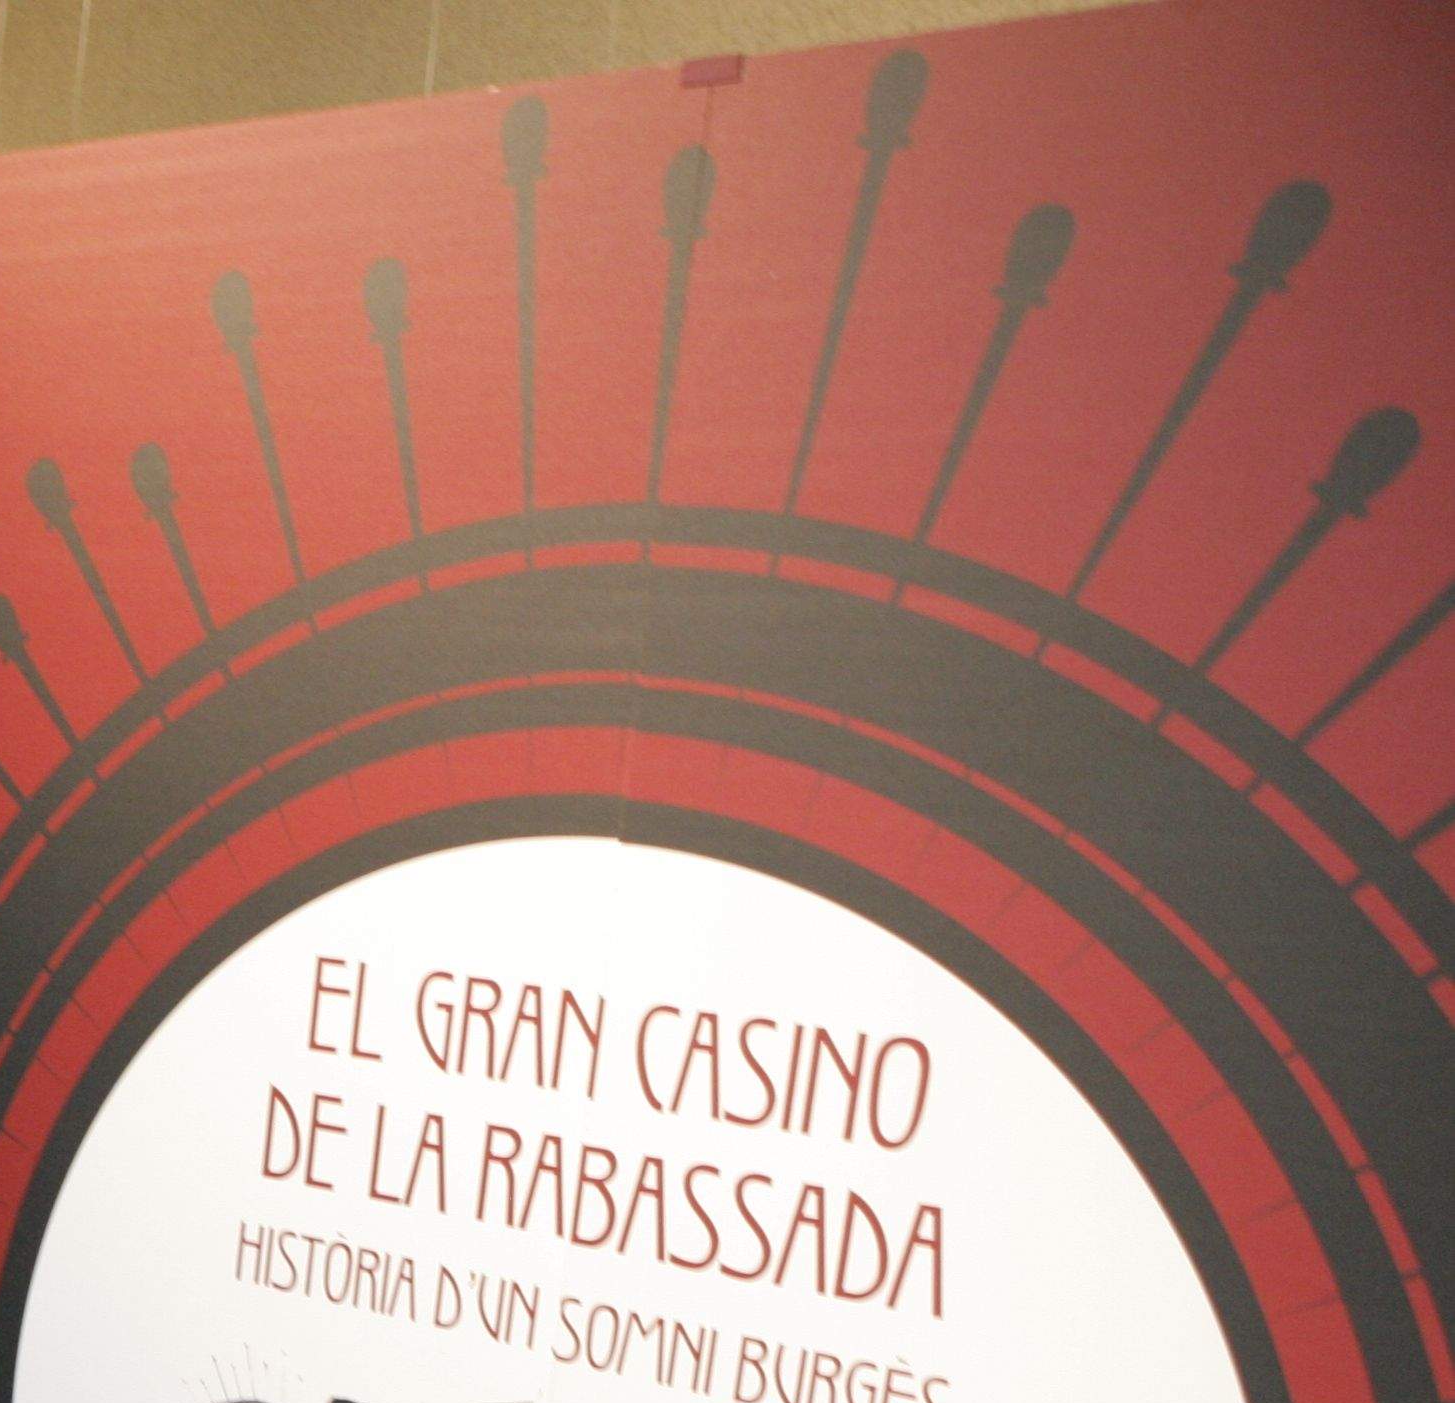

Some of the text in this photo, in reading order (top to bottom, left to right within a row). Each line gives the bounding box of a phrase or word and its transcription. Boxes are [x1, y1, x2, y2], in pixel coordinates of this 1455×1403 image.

[307, 956, 932, 1152] EL GRAN CASINO
[261, 1084, 945, 1320] DE LA RABASSADA
[235, 1222, 417, 1323] HISTÒRIA
[434, 1267, 541, 1350] D'UN
[553, 1296, 719, 1396] SOMNI
